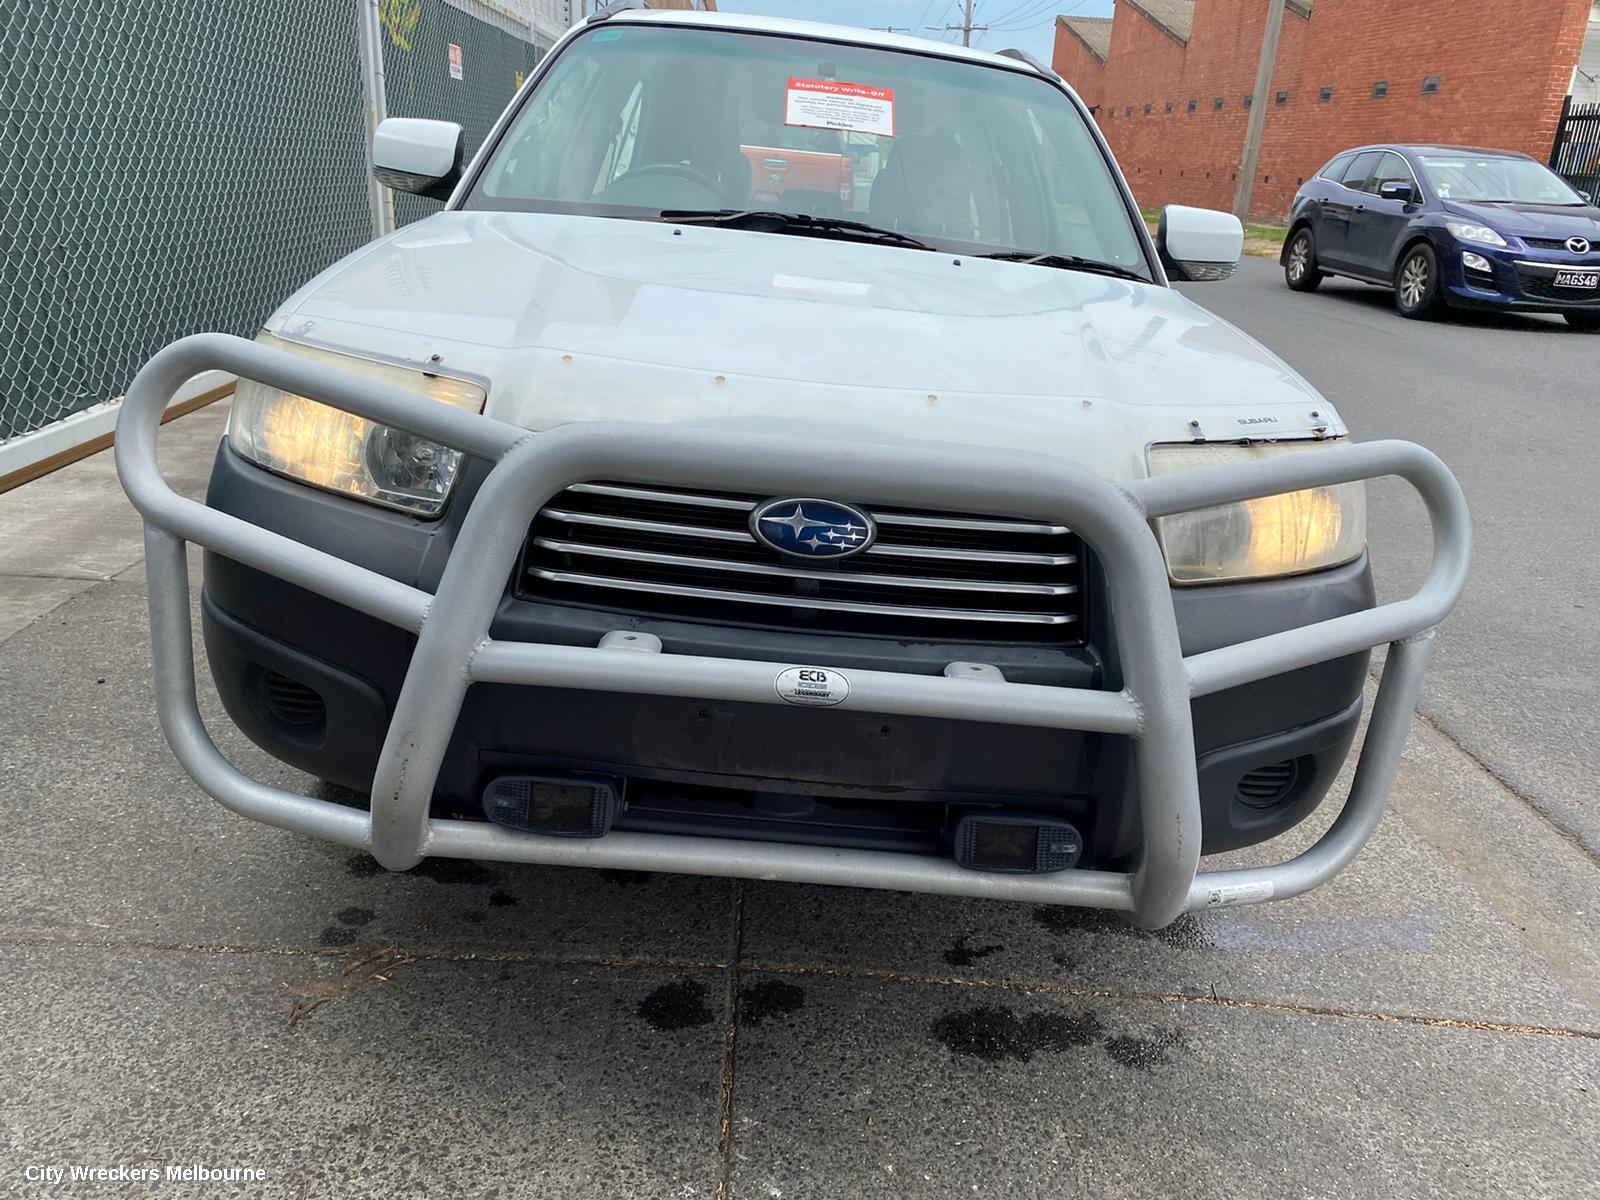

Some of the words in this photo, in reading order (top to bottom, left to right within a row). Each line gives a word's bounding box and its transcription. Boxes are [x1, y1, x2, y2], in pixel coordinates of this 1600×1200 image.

[795, 82, 839, 92] Statutory
[840, 87, 885, 98] Write-Off
[1237, 417, 1278, 425] SUBARU
[799, 670, 827, 682] ECB
[795, 689, 830, 698] LEGENDARY
